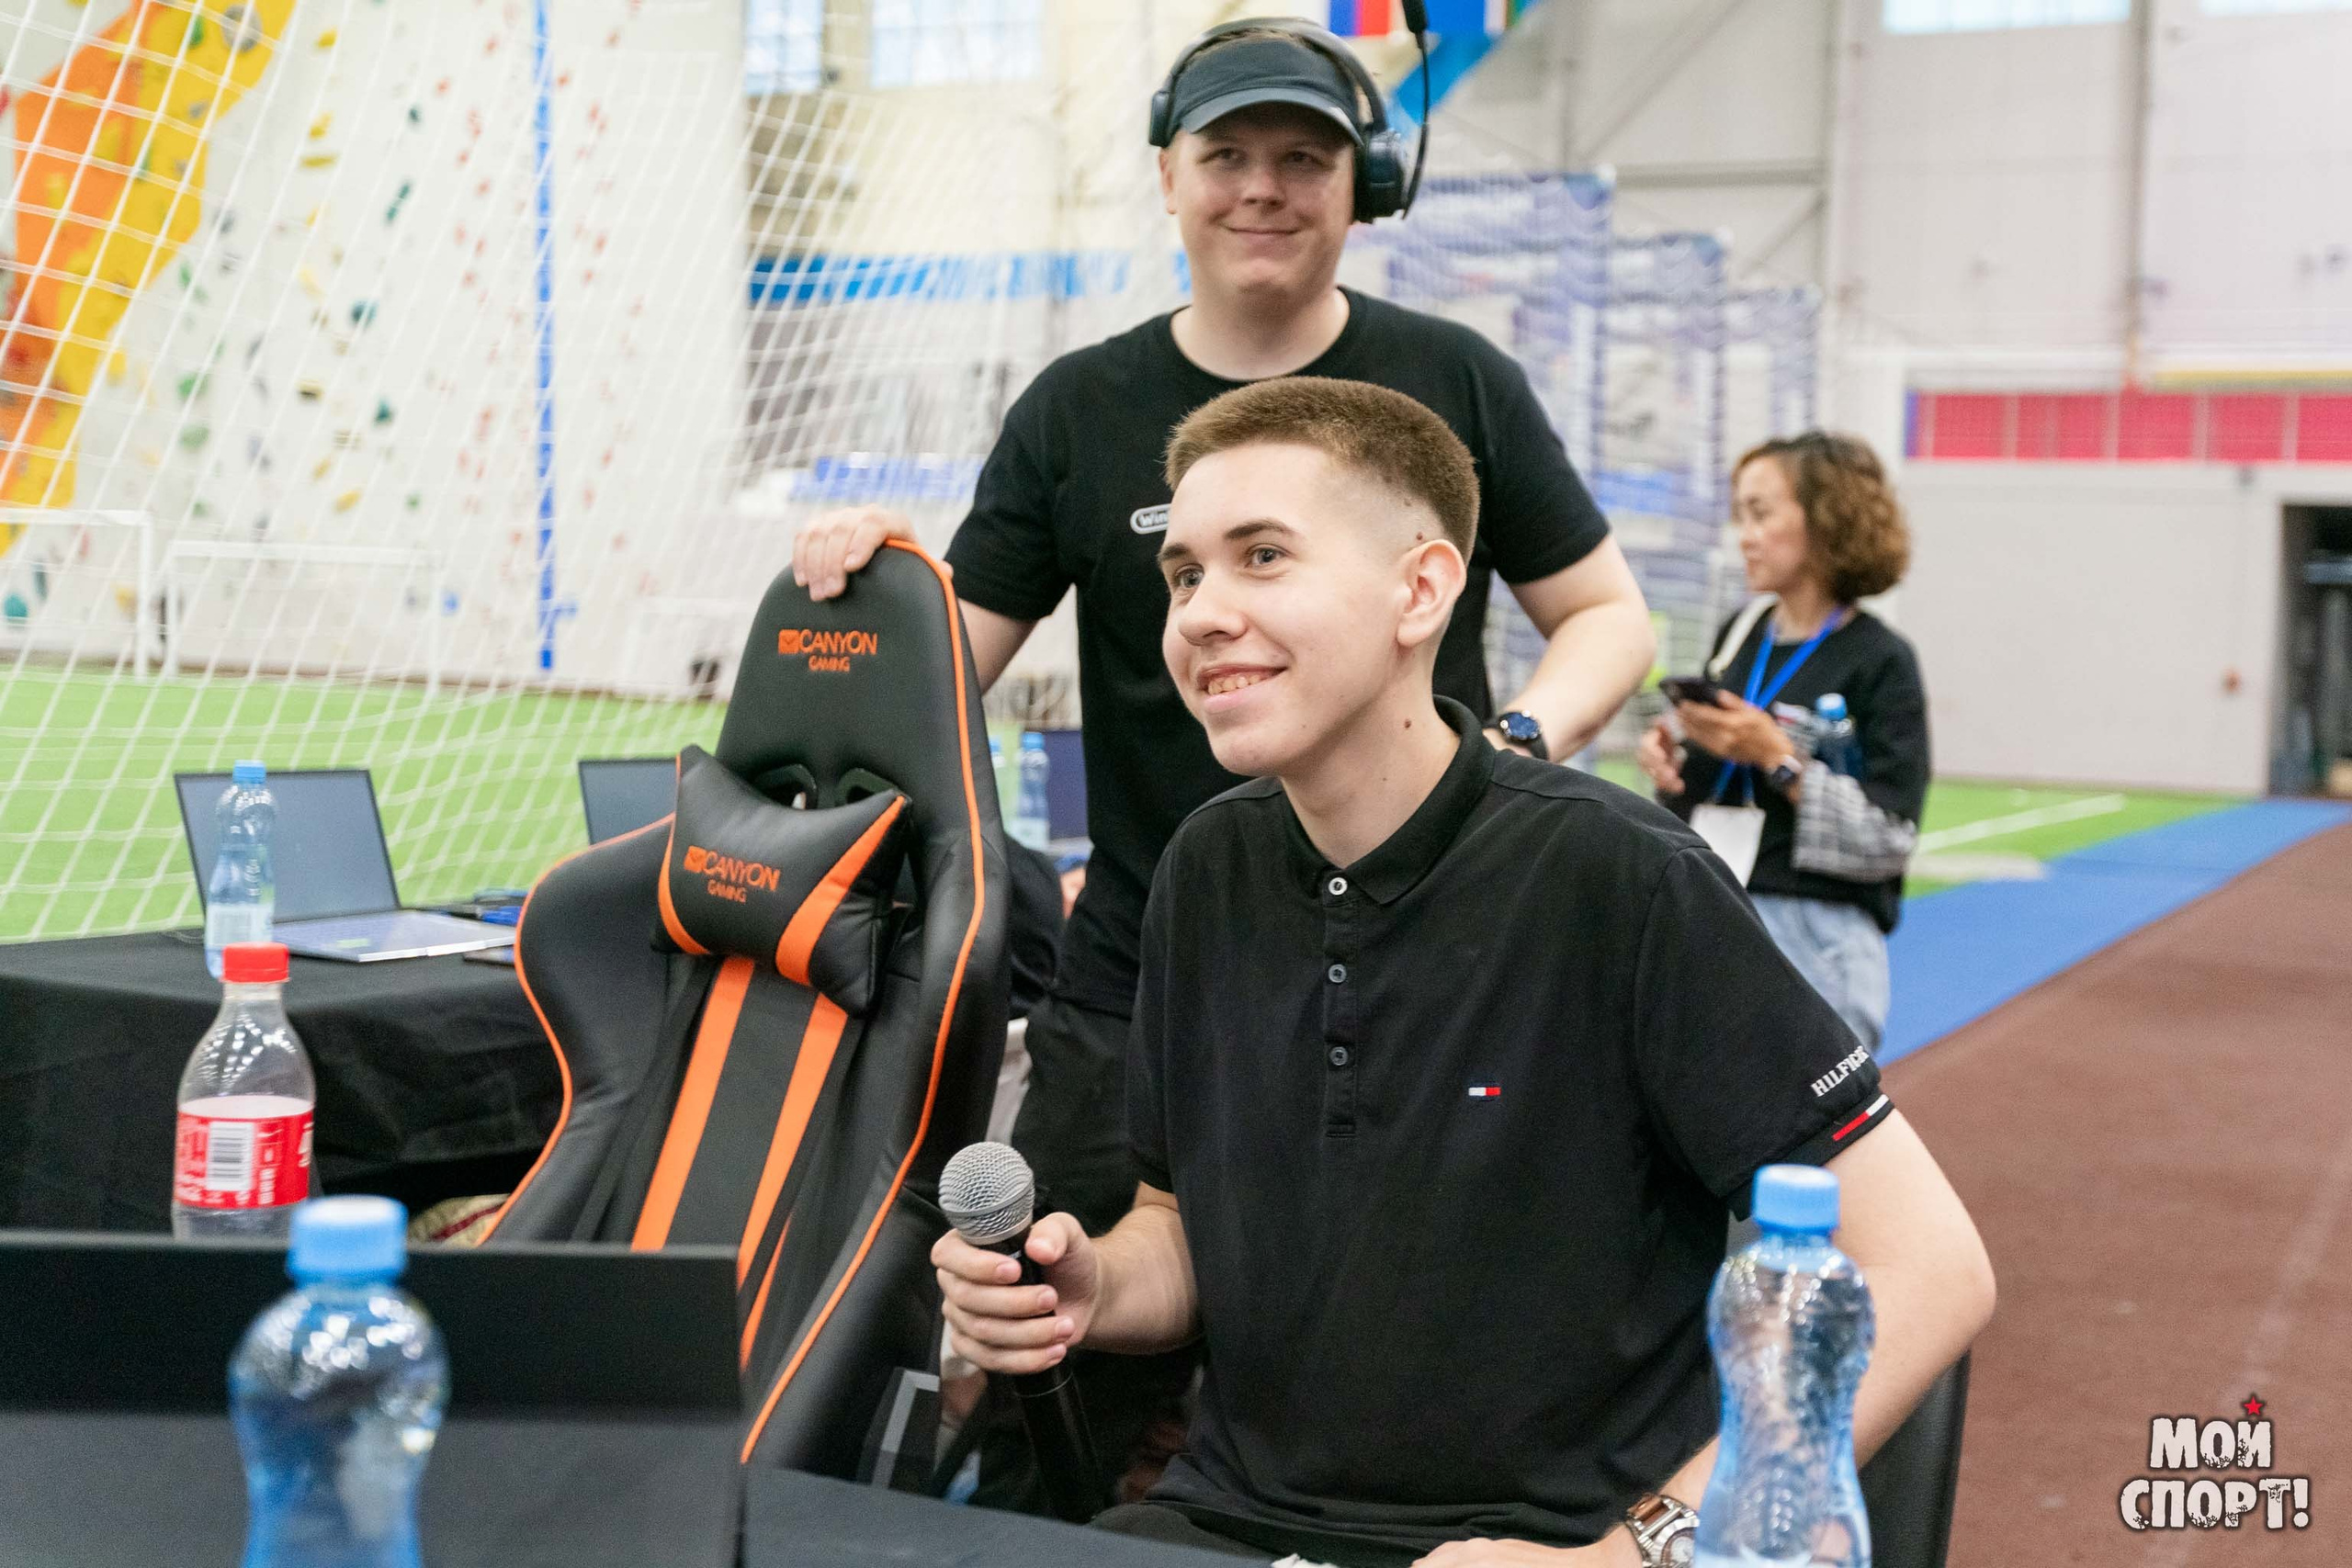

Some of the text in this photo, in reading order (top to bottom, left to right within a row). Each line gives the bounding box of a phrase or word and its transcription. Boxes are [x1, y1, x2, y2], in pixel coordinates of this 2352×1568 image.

[799, 629, 878, 655] CANYON
[808, 655, 851, 672] GAMING
[704, 851, 781, 891] CANYON
[707, 879, 748, 903] GAMING
